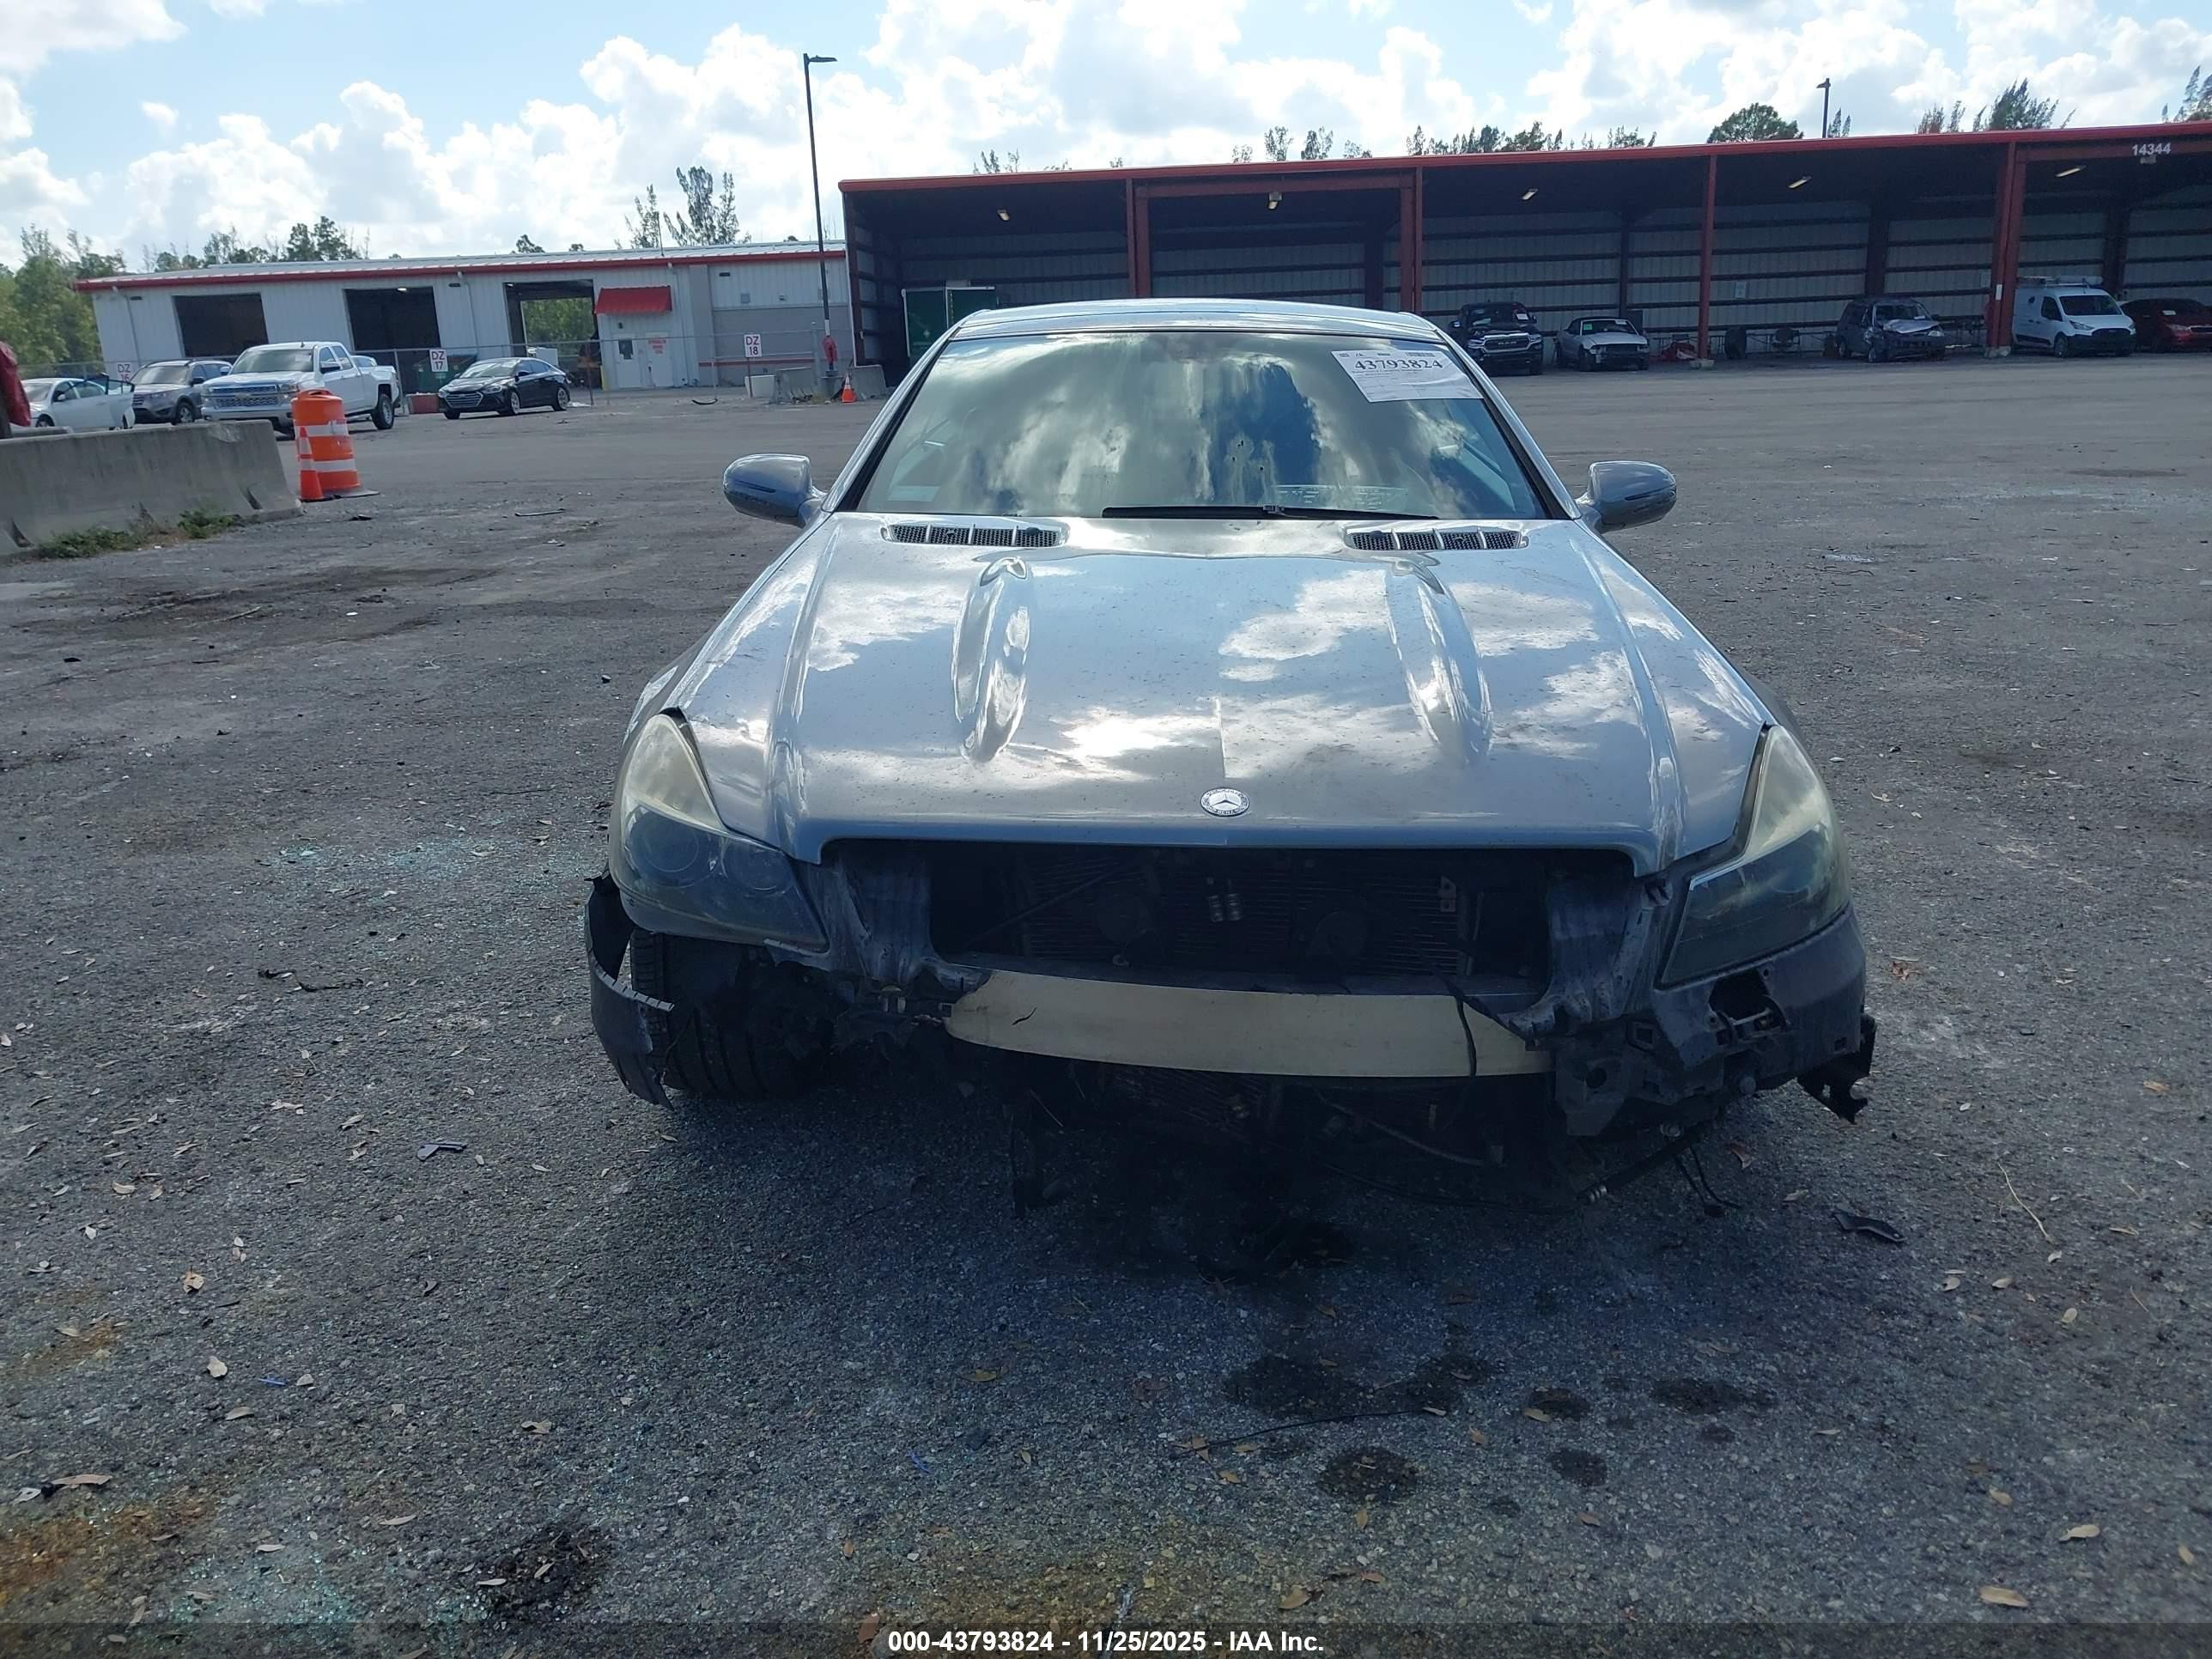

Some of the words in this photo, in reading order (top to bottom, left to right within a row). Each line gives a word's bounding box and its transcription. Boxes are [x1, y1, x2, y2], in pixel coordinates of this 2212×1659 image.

[2131, 143, 2172, 156] 14344
[745, 336, 760, 345] DZ
[431, 350, 446, 361] DZ
[749, 346, 759, 356] 18
[117, 363, 131, 373] DZ
[434, 361, 444, 370] 17
[1354, 359, 1443, 370] 43793824
